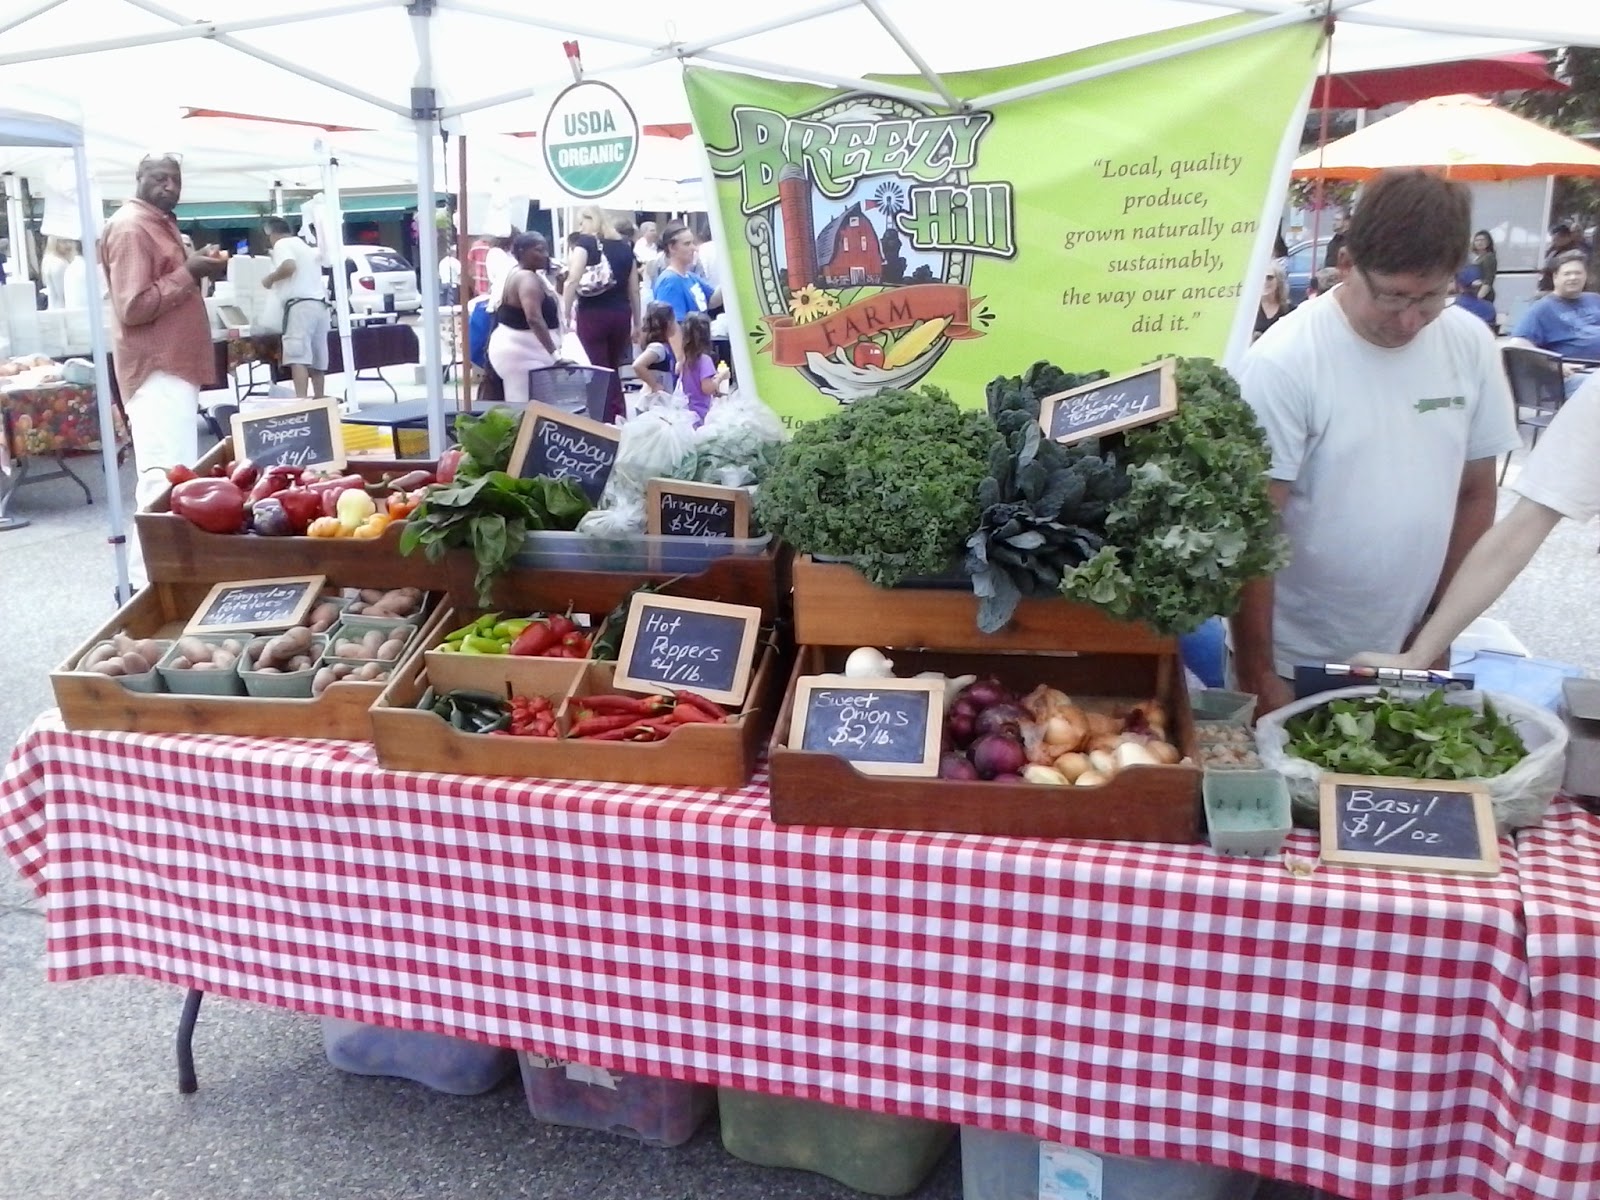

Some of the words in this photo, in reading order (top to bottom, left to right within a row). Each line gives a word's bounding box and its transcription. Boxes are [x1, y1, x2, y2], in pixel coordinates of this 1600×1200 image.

[564, 109, 616, 137] USDA
[558, 143, 624, 168] ORGANIC
[706, 106, 993, 214] BREEZY
[1170, 152, 1242, 179] quality
[1122, 188, 1208, 214] produce,
[896, 182, 1017, 260] Hill
[1064, 228, 1125, 249] grown
[1132, 217, 1224, 241] naturally
[1231, 220, 1260, 234] an
[1108, 249, 1224, 273] sustainably,
[1062, 287, 1091, 305] the
[1097, 291, 1136, 308] way
[1142, 289, 1176, 301] our
[821, 297, 914, 347] FARM
[1132, 314, 1163, 333] did
[266, 413, 309, 428] Sweet
[259, 426, 311, 446] Peppers
[538, 421, 614, 466] Rainbow
[545, 445, 603, 479] Chard
[645, 613, 681, 635] Hot
[650, 636, 721, 662] Peppers
[815, 692, 879, 708] Sweet
[1346, 790, 1439, 816] Basil
